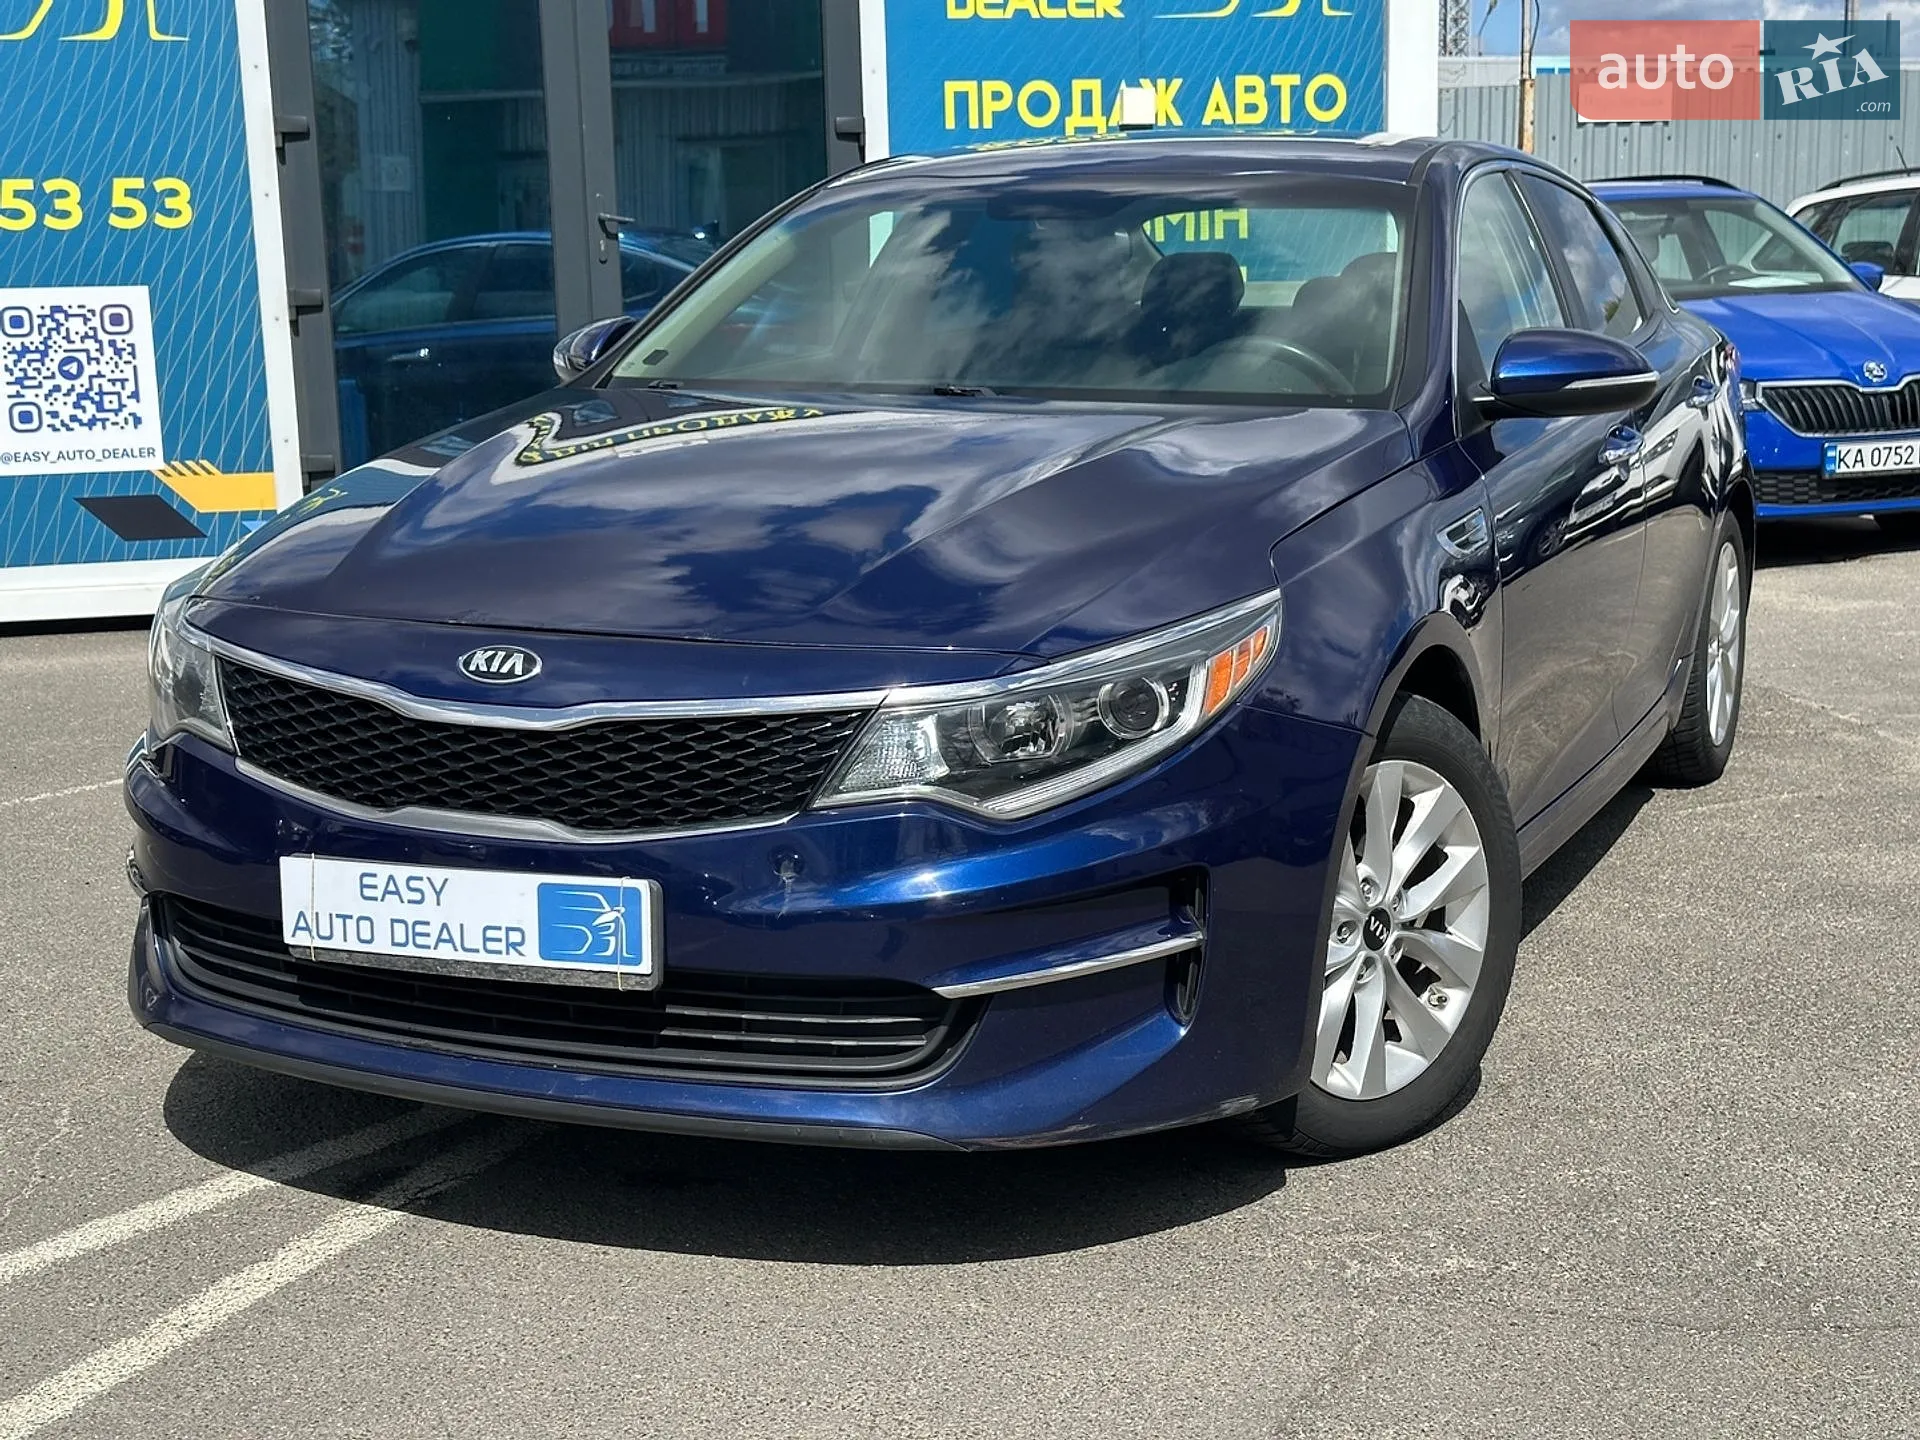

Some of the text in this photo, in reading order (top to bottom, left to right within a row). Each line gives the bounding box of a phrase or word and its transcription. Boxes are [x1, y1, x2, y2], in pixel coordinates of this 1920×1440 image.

[1202, 73, 1348, 126] АВТО
[0, 177, 194, 231] 53 53
[0, 447, 156, 465] @EASY_AUTO_DEALER
[1838, 448, 1865, 469] KA
[1870, 445, 1914, 467] 0752
[469, 650, 524, 676] KIA
[358, 872, 449, 906] EASY
[291, 911, 527, 957] AUTO DEALER
